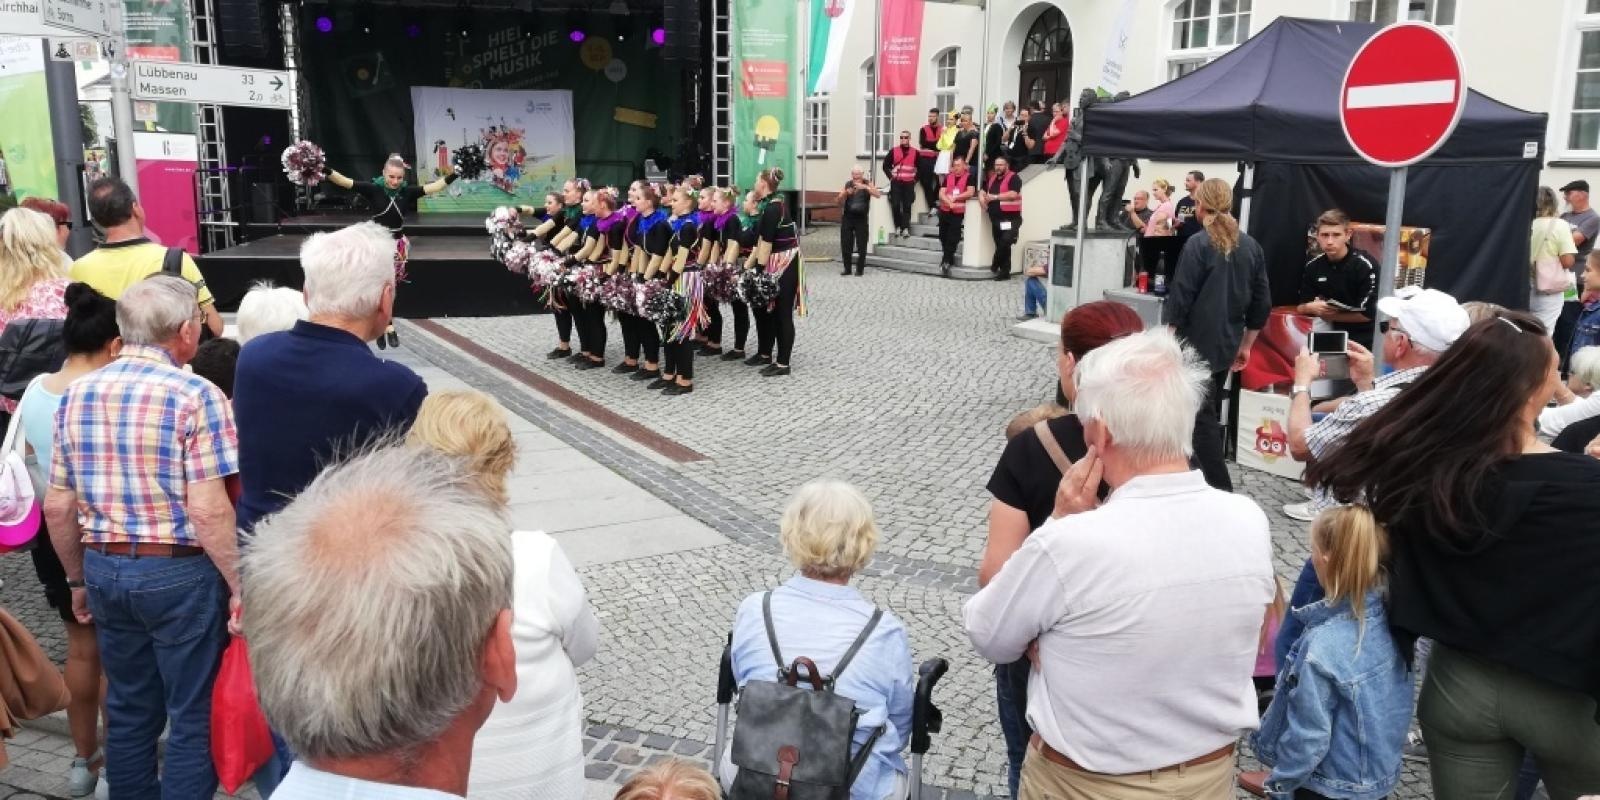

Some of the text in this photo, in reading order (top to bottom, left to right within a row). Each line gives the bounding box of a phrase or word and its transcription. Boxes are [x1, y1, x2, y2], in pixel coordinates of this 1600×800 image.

[472, 29, 560, 69] SPIELT DIE
[139, 65, 254, 85] Lübbenau 33
[489, 51, 543, 81] MUSIK
[140, 82, 187, 96] Massen
